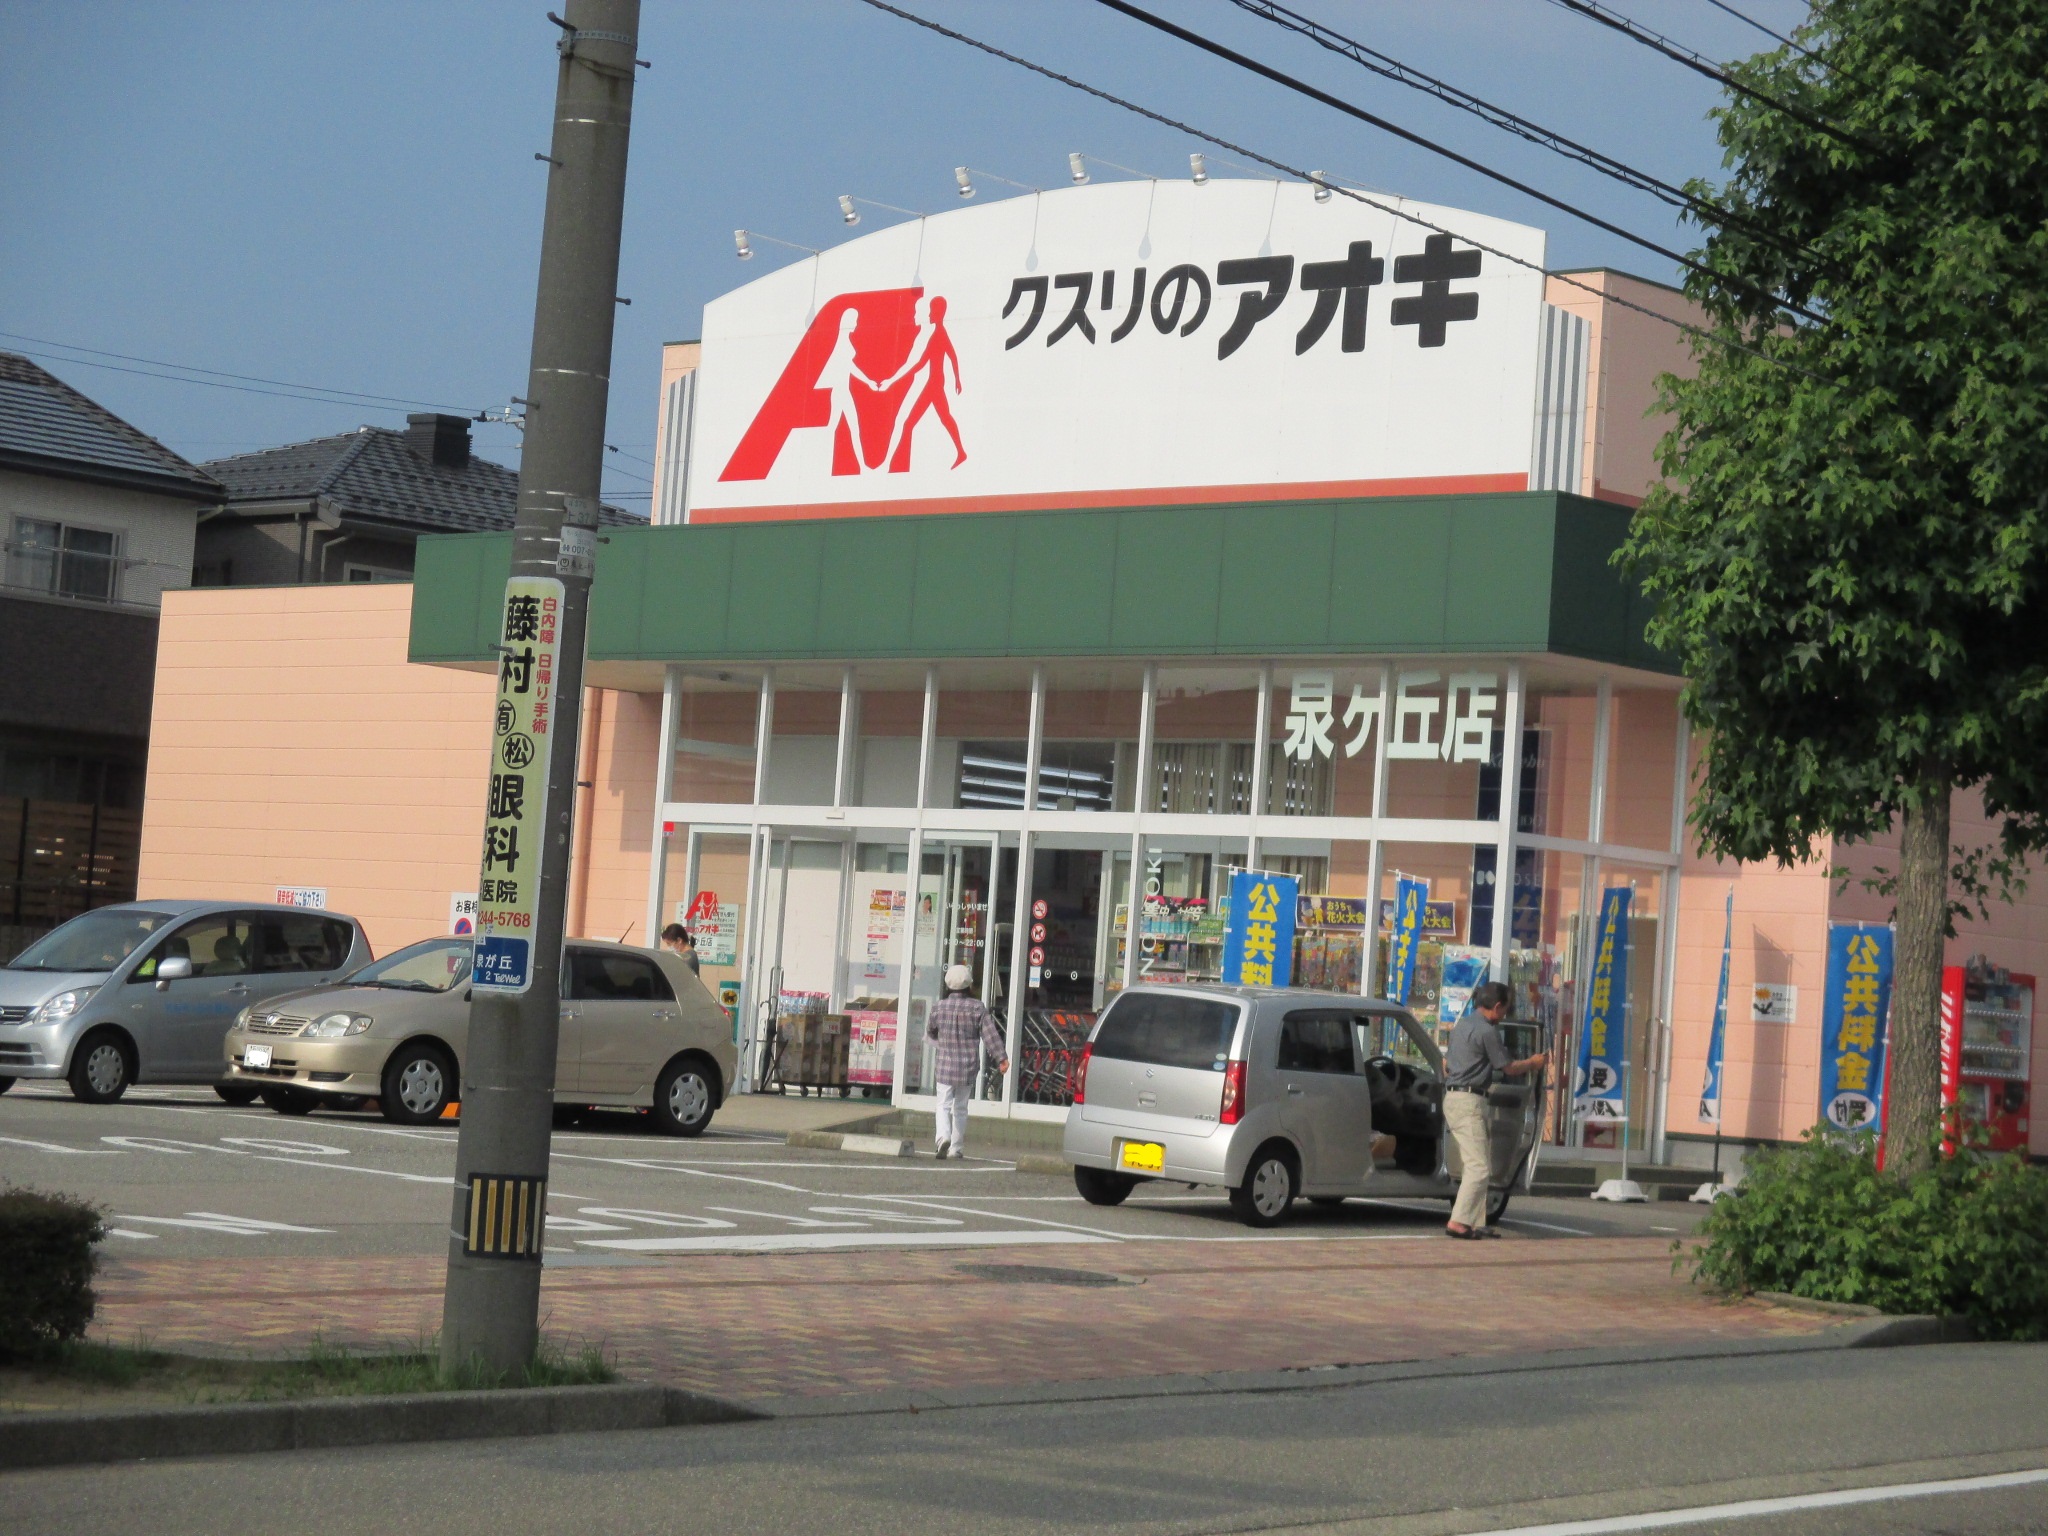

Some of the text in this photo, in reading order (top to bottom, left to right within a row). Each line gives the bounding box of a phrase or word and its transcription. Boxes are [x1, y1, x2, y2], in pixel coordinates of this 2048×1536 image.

[1002, 234, 1482, 361] クスリのアオキ
[532, 597, 557, 734] 白内障 日帰り手術
[1326, 911, 1366, 924] 花火大会
[1421, 915, 1452, 928] 火大会
